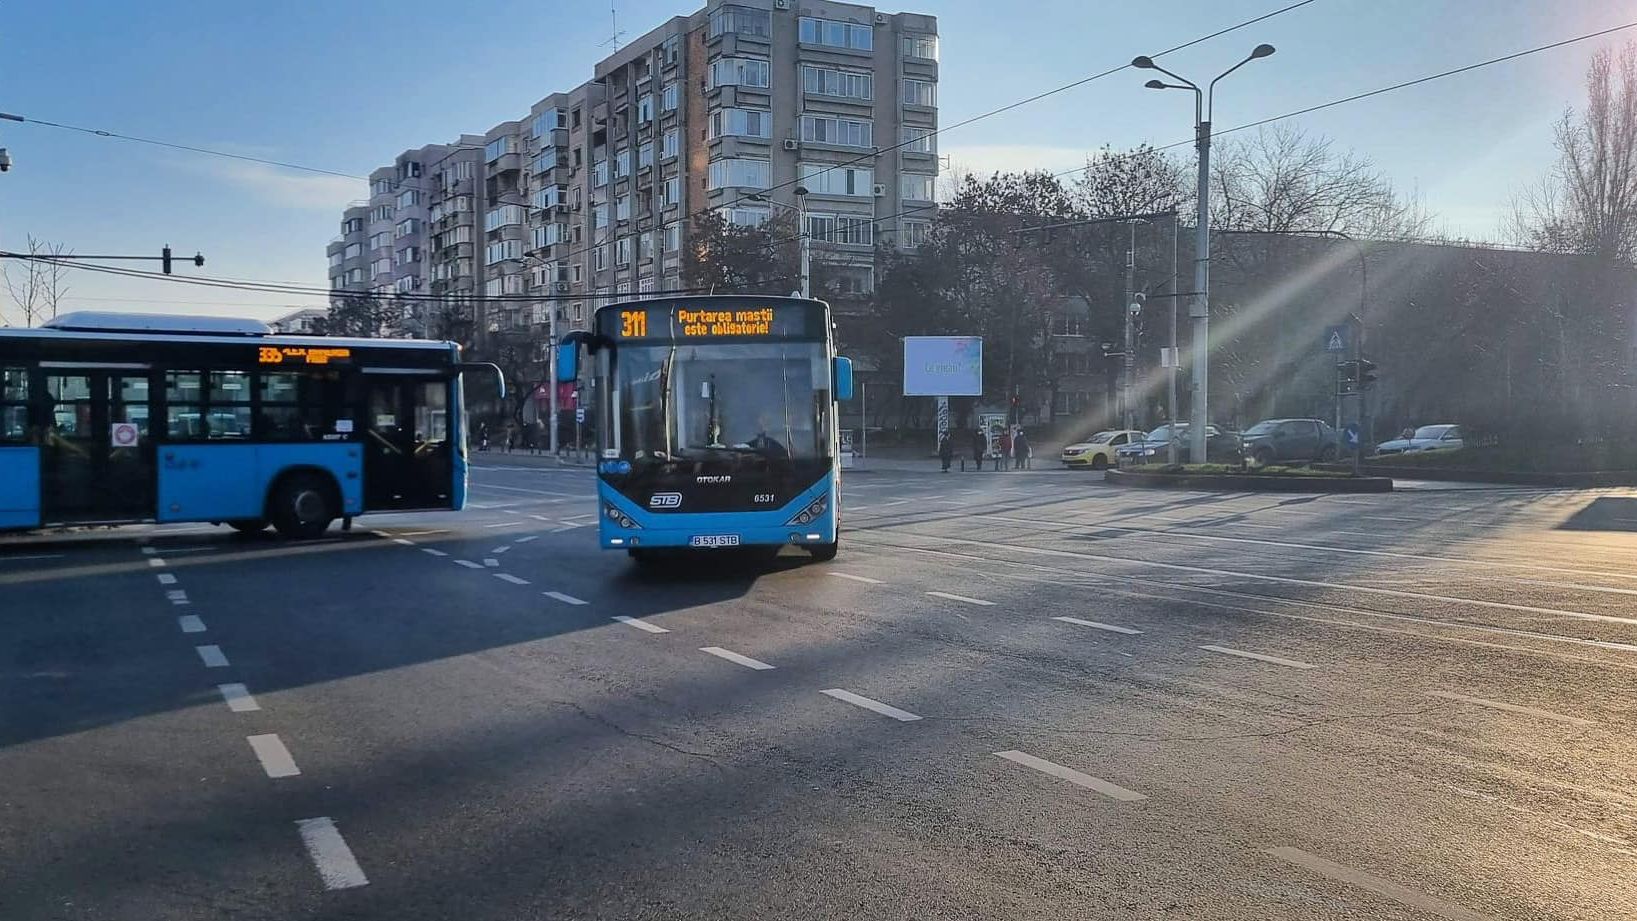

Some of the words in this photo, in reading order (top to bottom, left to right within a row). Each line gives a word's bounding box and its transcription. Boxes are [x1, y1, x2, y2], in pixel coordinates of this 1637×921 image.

[678, 309, 732, 323] Purtarea
[735, 308, 774, 322] mastii
[620, 310, 647, 337] 311
[684, 323, 708, 336] este
[711, 321, 769, 336] obligatorie!
[696, 476, 732, 484] OTOKAR
[649, 495, 680, 506] STB
[754, 494, 775, 503] 6531
[694, 536, 701, 545] B
[703, 536, 718, 545] 531
[719, 536, 738, 545] STB
